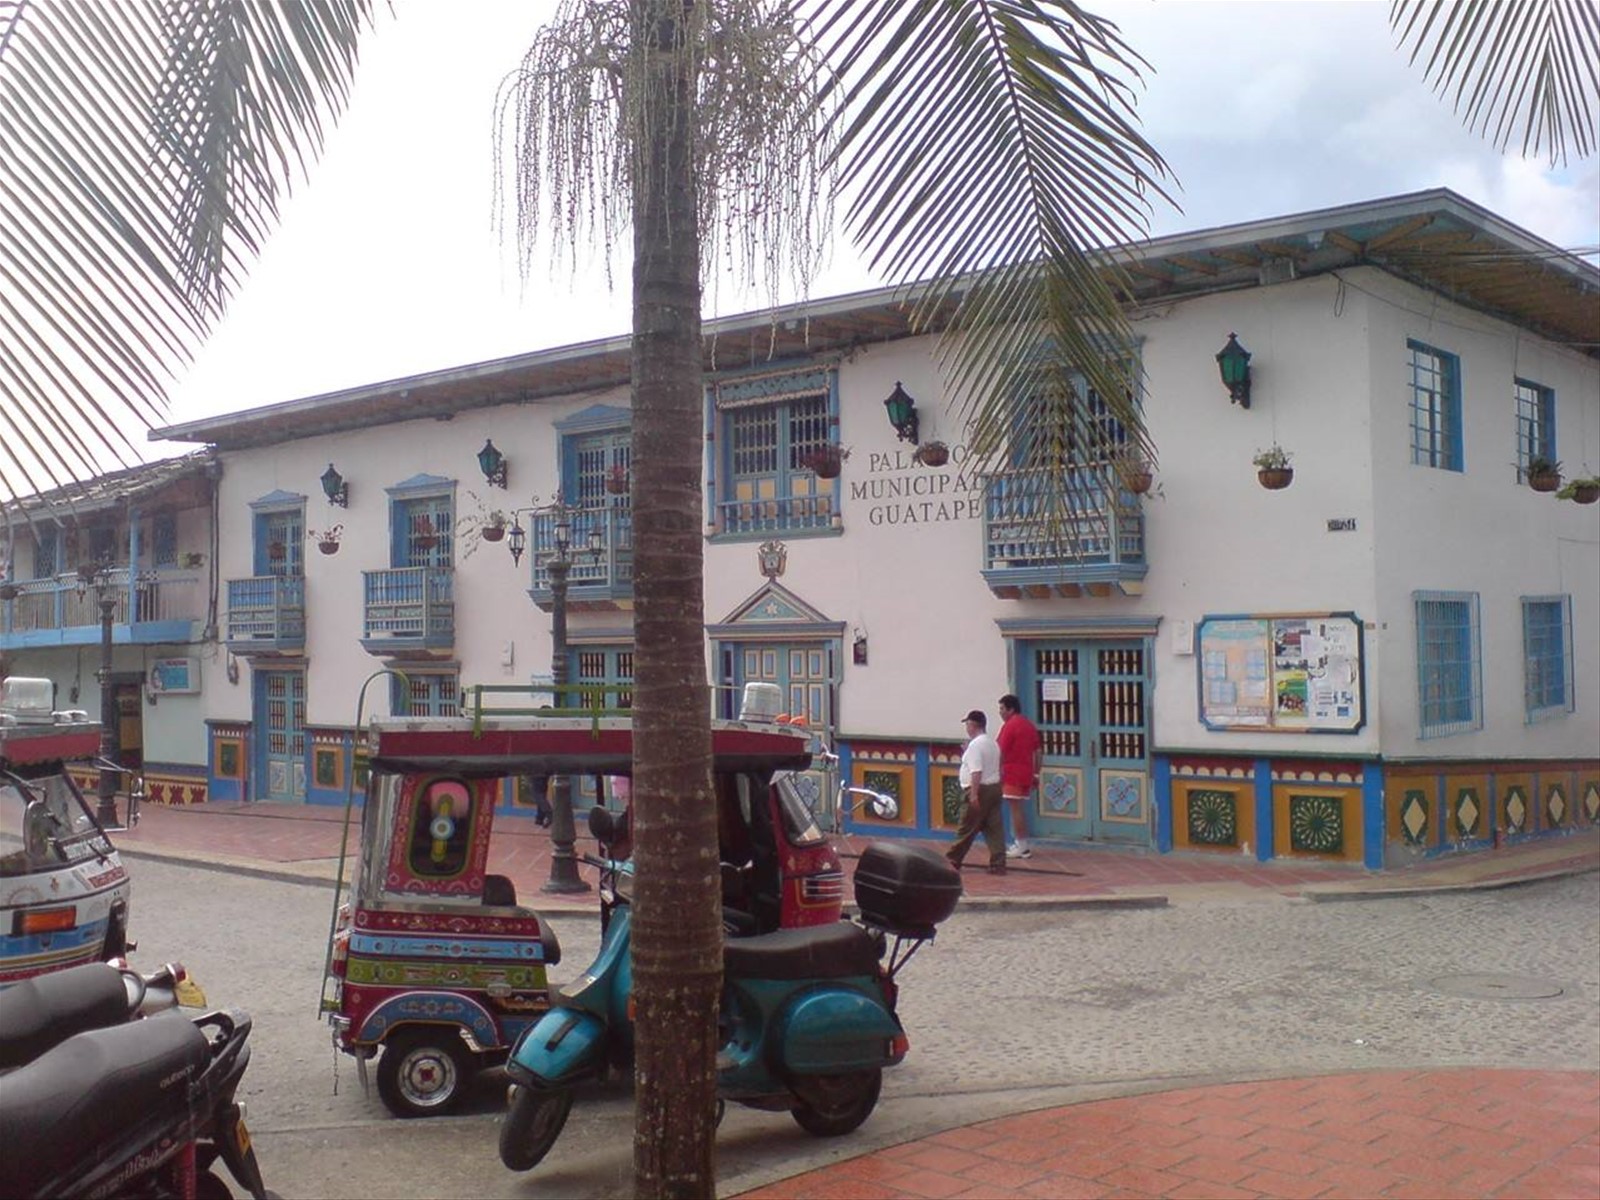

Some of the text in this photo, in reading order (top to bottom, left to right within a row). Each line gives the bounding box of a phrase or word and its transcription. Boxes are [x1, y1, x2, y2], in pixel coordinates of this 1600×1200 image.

[869, 444, 967, 473] PALO
[850, 471, 981, 500] MUNICIPAL
[869, 499, 982, 526] GUATAPE
